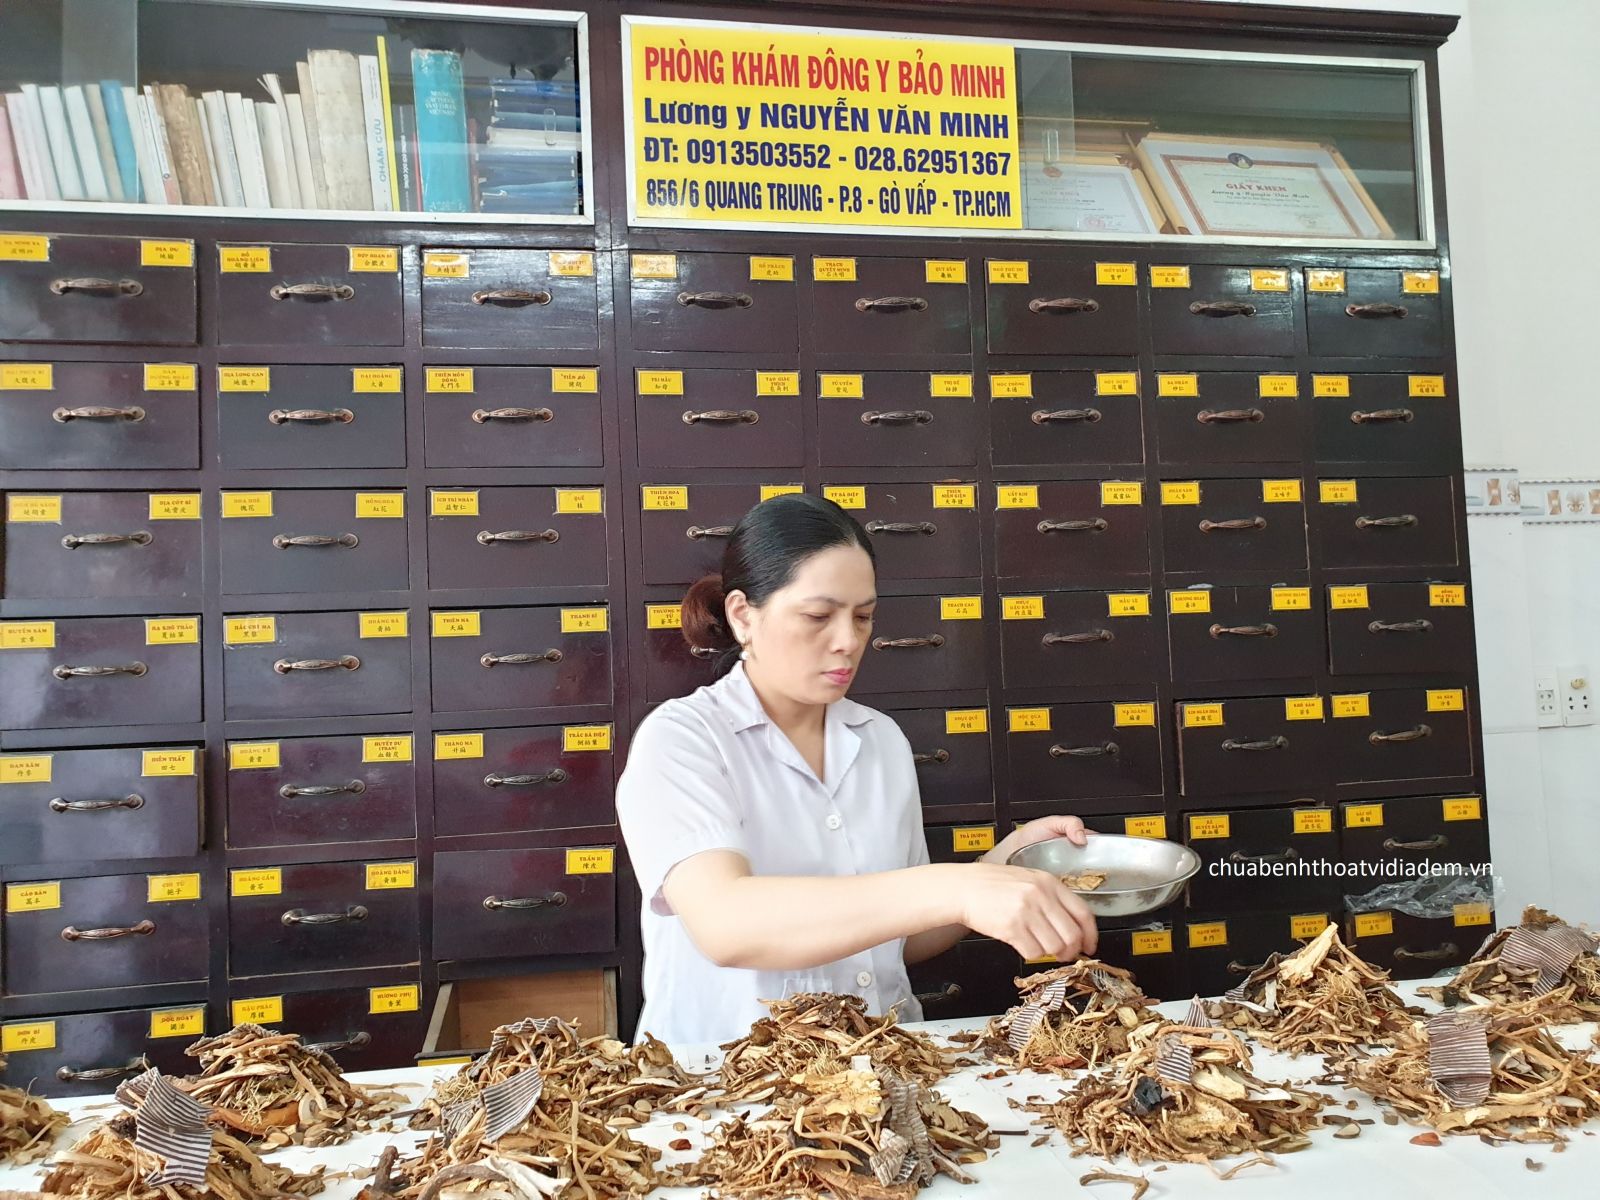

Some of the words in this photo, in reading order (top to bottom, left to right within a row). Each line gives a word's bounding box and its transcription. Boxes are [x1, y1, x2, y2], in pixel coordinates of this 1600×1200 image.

[645, 39, 723, 84] PHÒNG
[733, 45, 799, 88] KHÁM
[808, 48, 869, 91] ĐÔNG
[876, 60, 890, 92] Y
[900, 49, 942, 95] BẢO
[951, 65, 1005, 98] MINH
[645, 98, 727, 129] Lương
[737, 106, 751, 130] y
[761, 97, 869, 132] NGUYỄN
[878, 104, 931, 135] VĂN
[941, 111, 1008, 138] MINH
[644, 137, 679, 163] ĐT:
[687, 138, 831, 169] 0913503552
[855, 146, 1011, 176] 028.62951367
[646, 179, 699, 208] 856/6
[705, 181, 762, 210] QUANG
[767, 183, 822, 212] TRUNG
[840, 188, 862, 213] P.8
[879, 181, 900, 215] GÒ
[906, 178, 937, 215] VẤP
[953, 190, 1011, 217] TP.HCM
